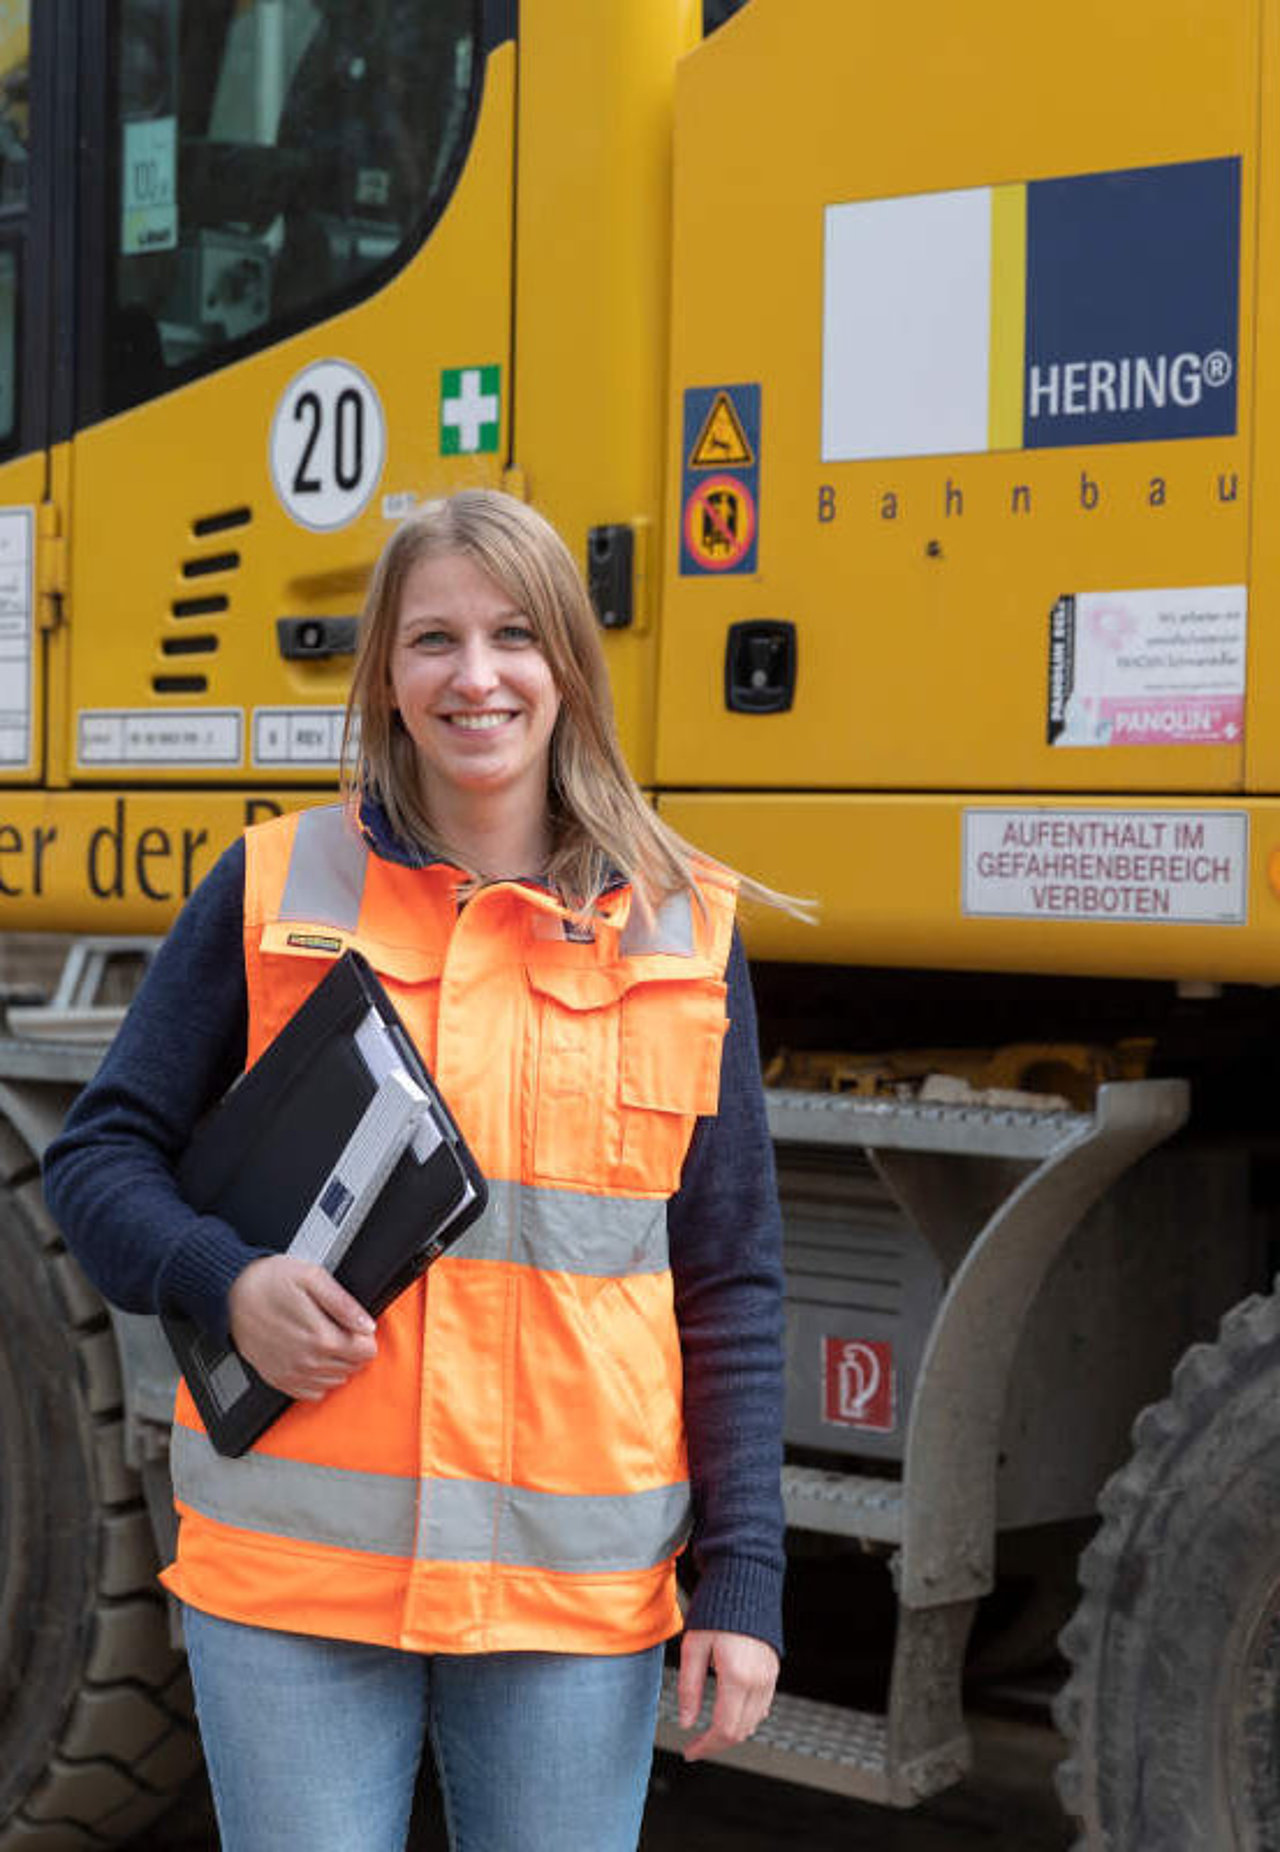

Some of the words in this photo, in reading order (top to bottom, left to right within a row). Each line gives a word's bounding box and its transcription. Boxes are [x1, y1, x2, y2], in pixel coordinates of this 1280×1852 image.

[293, 388, 364, 493] 20
[87, 796, 208, 902] der
[1002, 821, 1167, 849] AUFENTHALT
[1174, 823, 1206, 850] IM
[976, 851, 1231, 883] GEFAHRENBEREICH
[1031, 884, 1171, 914] VERBOTEN
